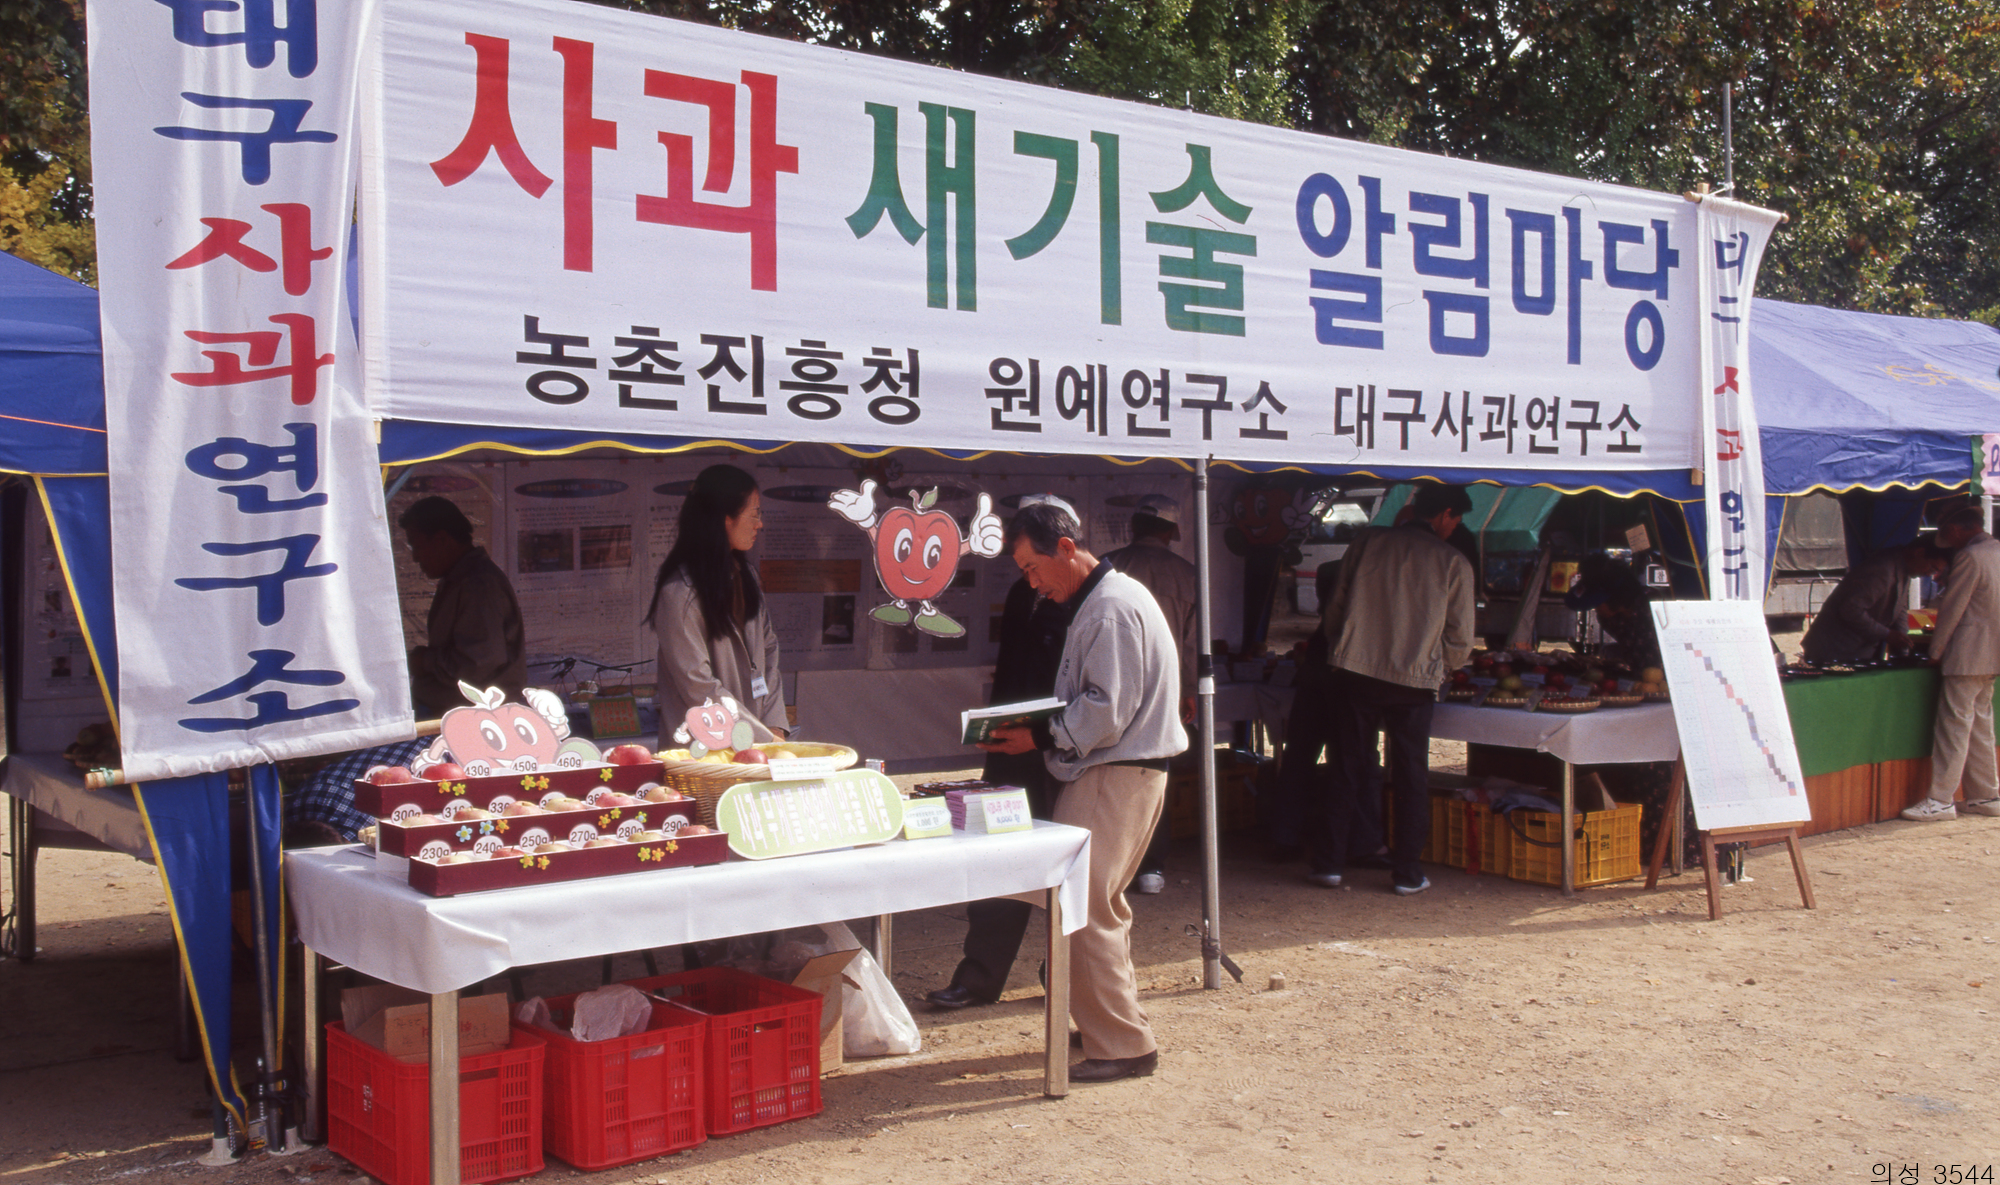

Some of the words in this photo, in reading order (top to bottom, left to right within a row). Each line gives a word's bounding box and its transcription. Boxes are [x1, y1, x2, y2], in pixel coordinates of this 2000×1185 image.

[429, 32, 798, 292] 사과
[844, 101, 1257, 337] 새기술
[1296, 172, 1679, 371] 알림마당
[516, 314, 921, 424] 농촌진흥청
[984, 357, 1287, 440] 원예연구소
[1334, 384, 1642, 455] 대구사과연구소
[512, 760, 537, 772] 450g
[557, 756, 581, 768] 460g
